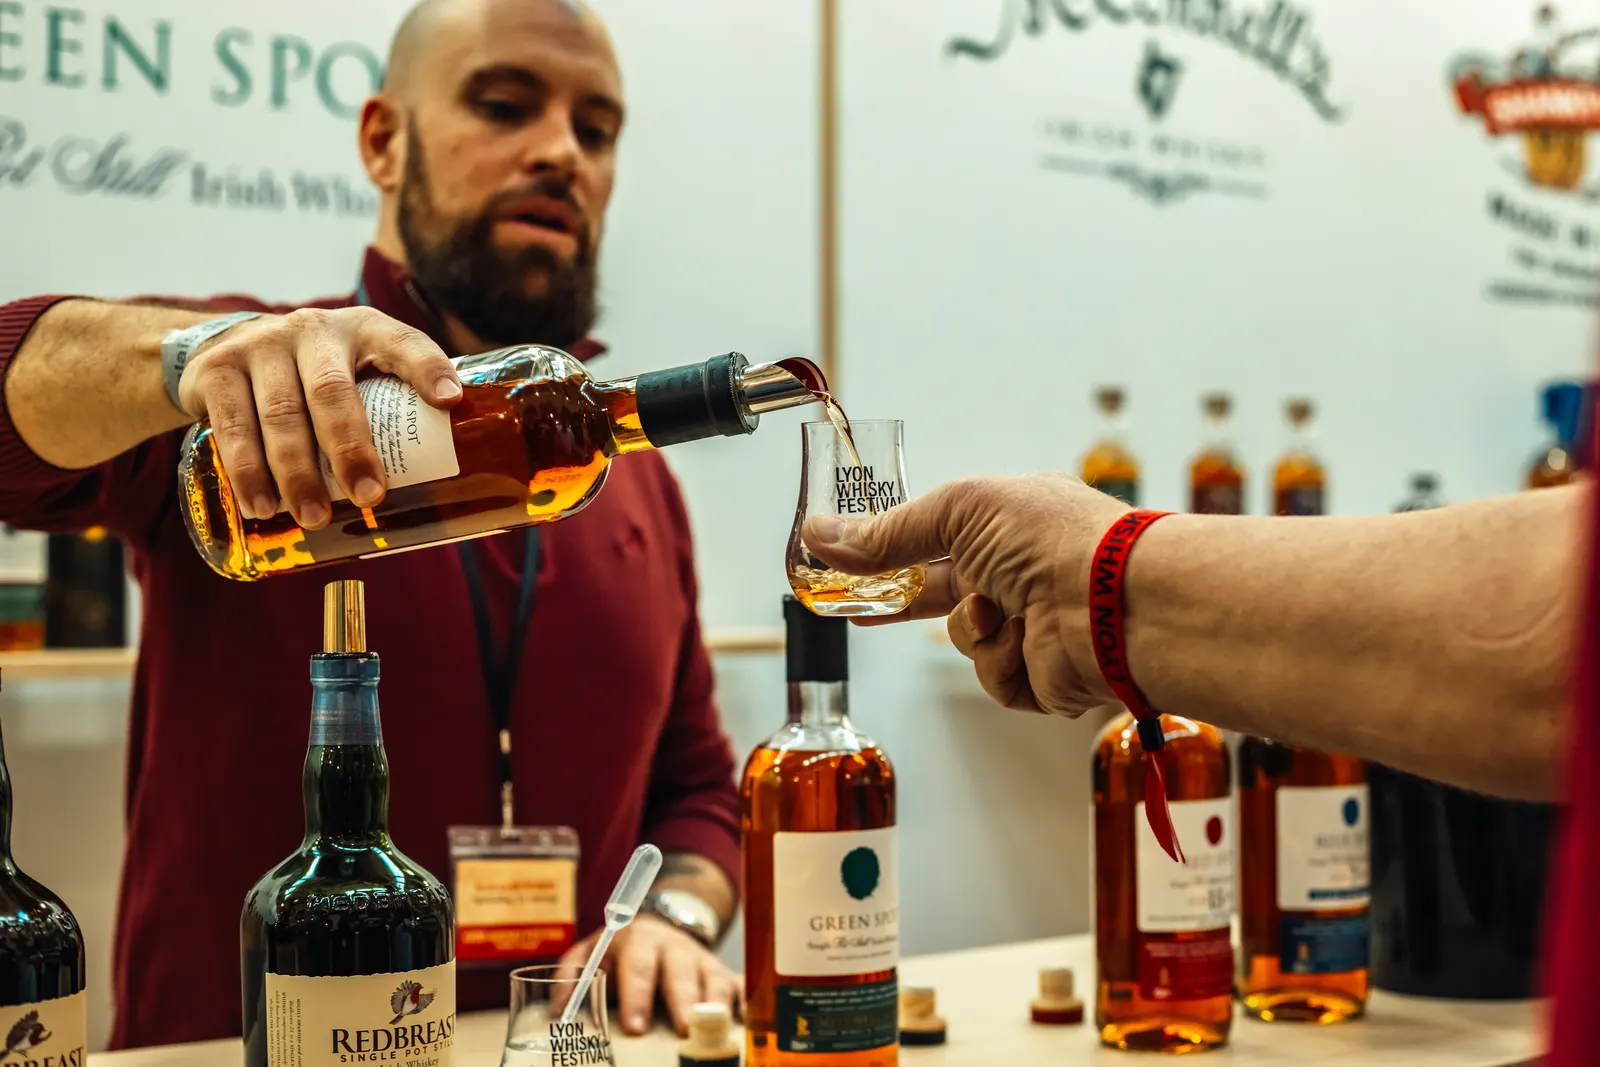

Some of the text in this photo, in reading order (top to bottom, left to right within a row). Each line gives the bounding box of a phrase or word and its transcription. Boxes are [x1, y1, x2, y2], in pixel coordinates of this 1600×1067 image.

[210, 26, 385, 121] SPO
[407, 410, 419, 442] SPOT
[836, 466, 874, 482] LYON
[836, 481, 895, 498] WHISKY
[1094, 512, 1145, 683] LYON WHISK
[809, 914, 870, 932] GREEN
[331, 1012, 457, 1054] REDBREAST
[549, 1022, 584, 1038] LYON
[340, 1037, 454, 1063] SINGLE POT STILL
[550, 1034, 601, 1053] WHISKY
